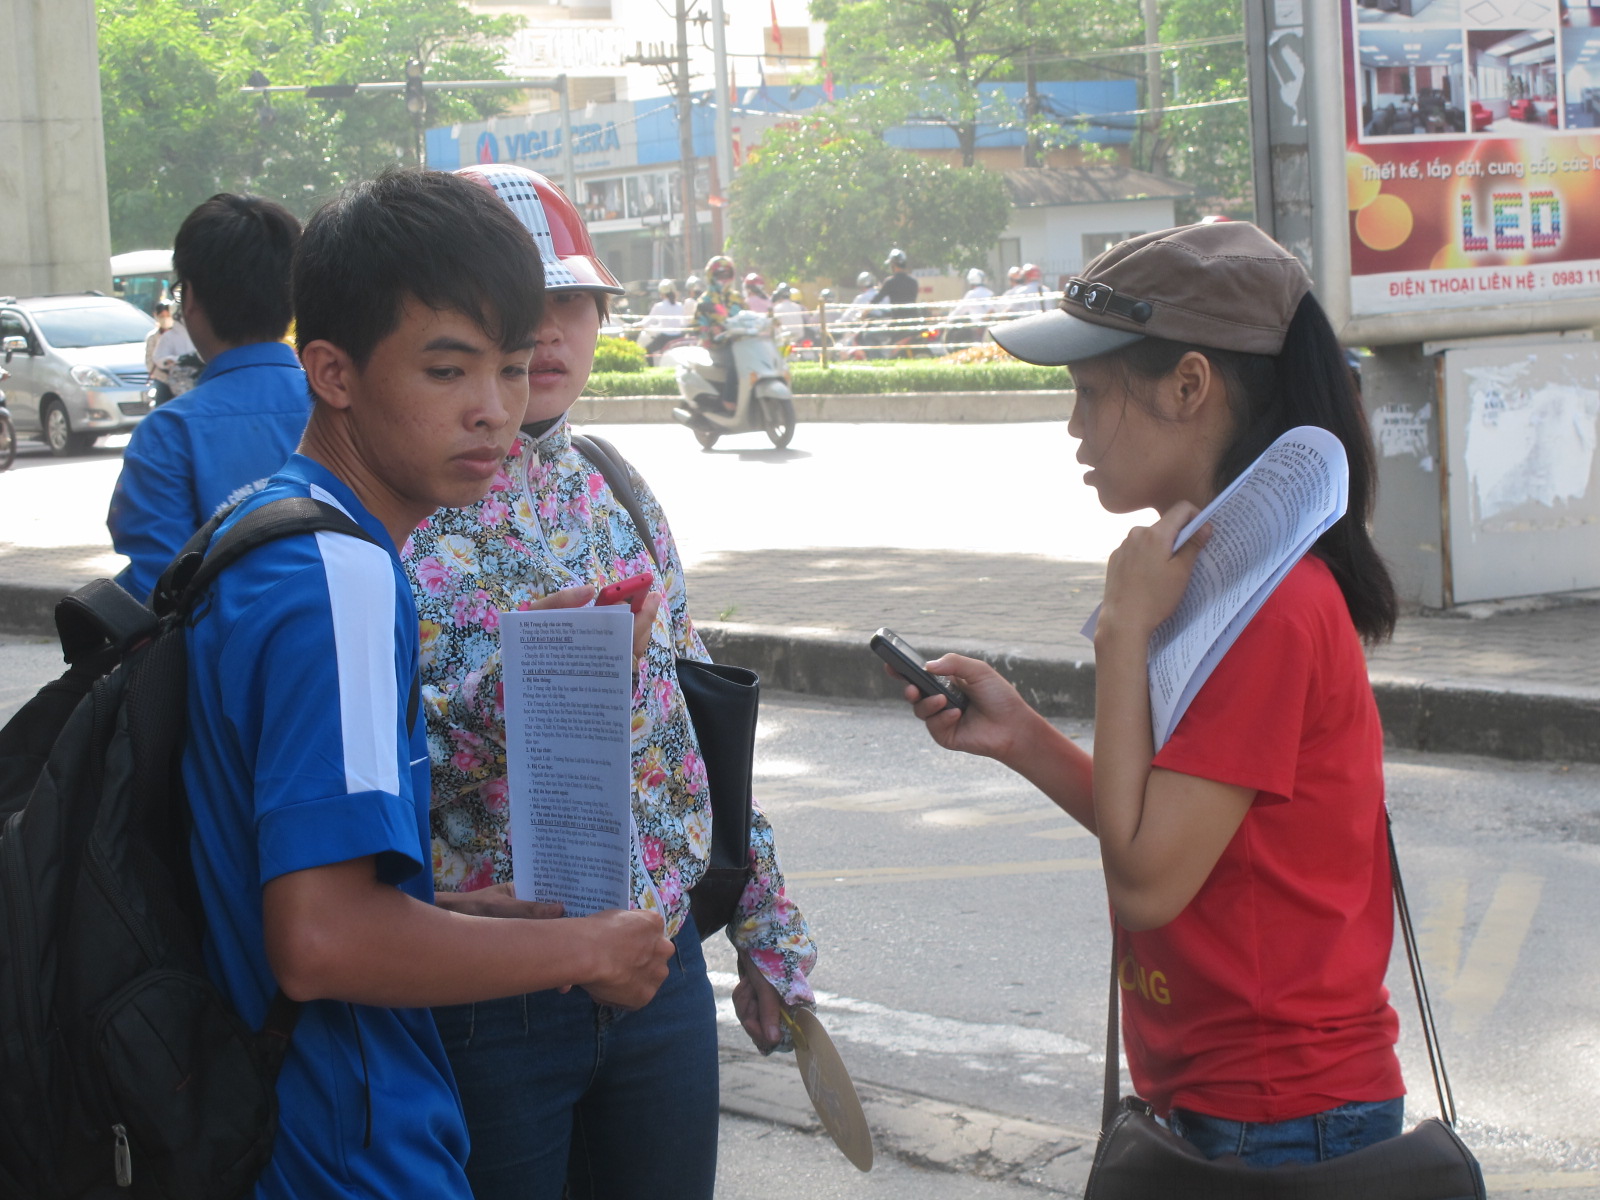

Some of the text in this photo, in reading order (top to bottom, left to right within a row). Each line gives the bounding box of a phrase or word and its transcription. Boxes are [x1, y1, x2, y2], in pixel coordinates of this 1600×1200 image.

[1361, 160, 1396, 180] Thiết
[1400, 160, 1424, 180] kế,
[1427, 157, 1452, 179] lắp
[1488, 162, 1525, 178] cung
[1529, 156, 1557, 174] cấp
[1561, 156, 1589, 172] các
[1461, 190, 1561, 252] LED
[1389, 277, 1425, 298] ĐIỆN
[1429, 275, 1475, 295] THOẠI
[1478, 271, 1513, 290] LIÊN
[1515, 271, 1536, 292] HỆ
[1552, 270, 1583, 286] 0983
